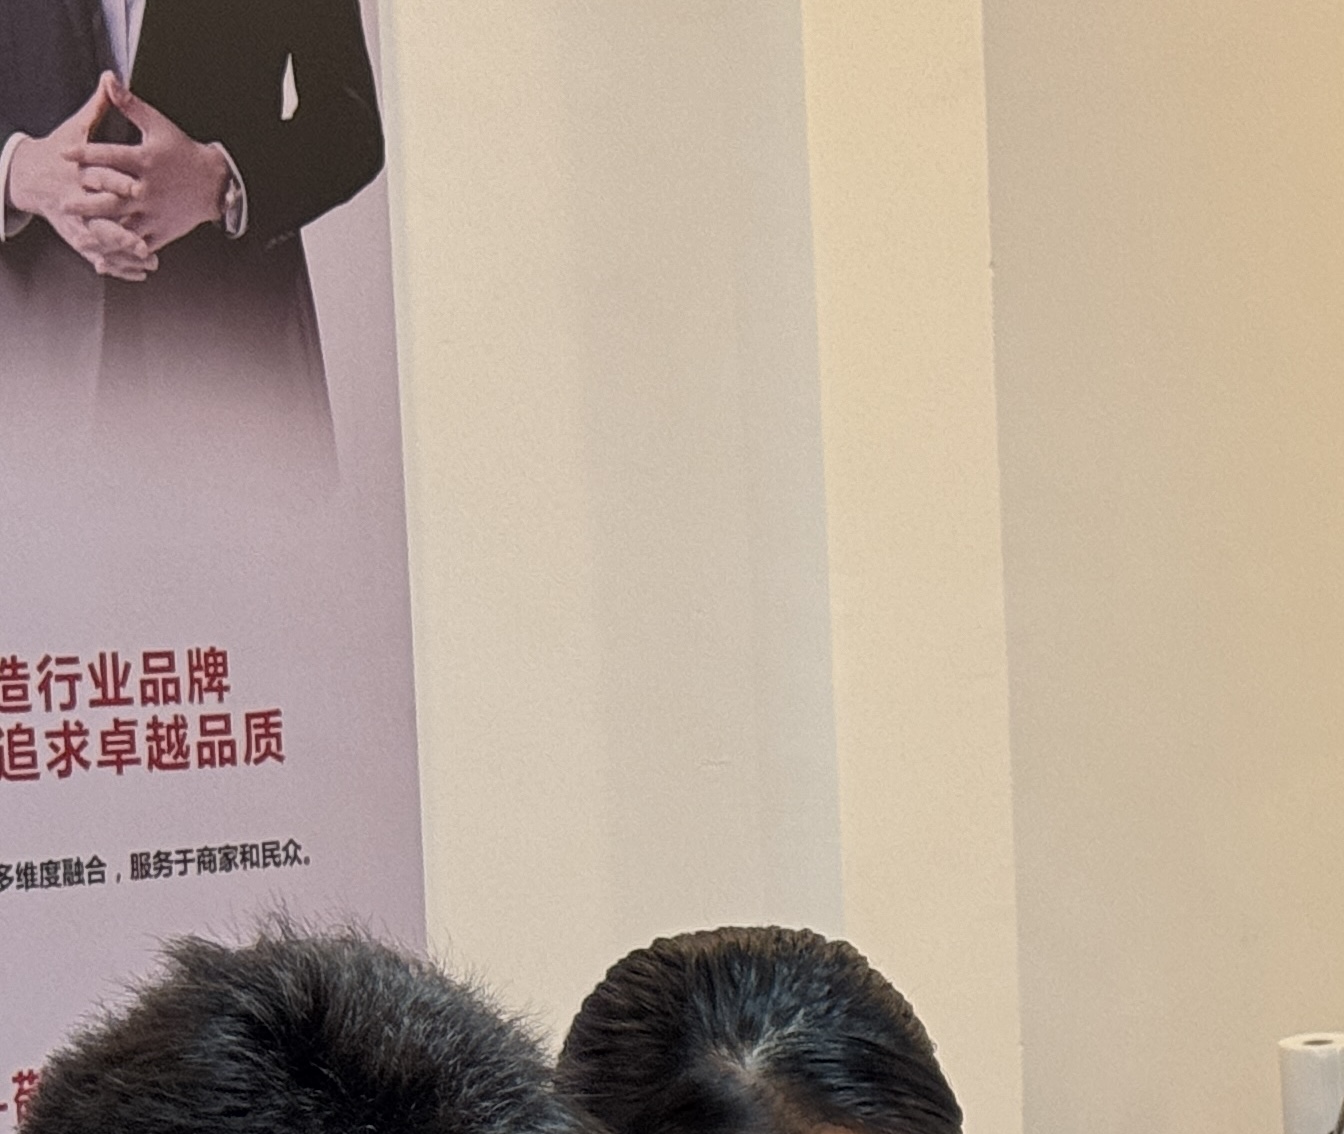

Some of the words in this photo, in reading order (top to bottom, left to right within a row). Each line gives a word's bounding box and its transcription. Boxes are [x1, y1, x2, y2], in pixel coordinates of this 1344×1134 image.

[0, 647, 231, 713] 造行业品牌
[0, 708, 286, 781] 追求卓越品质
